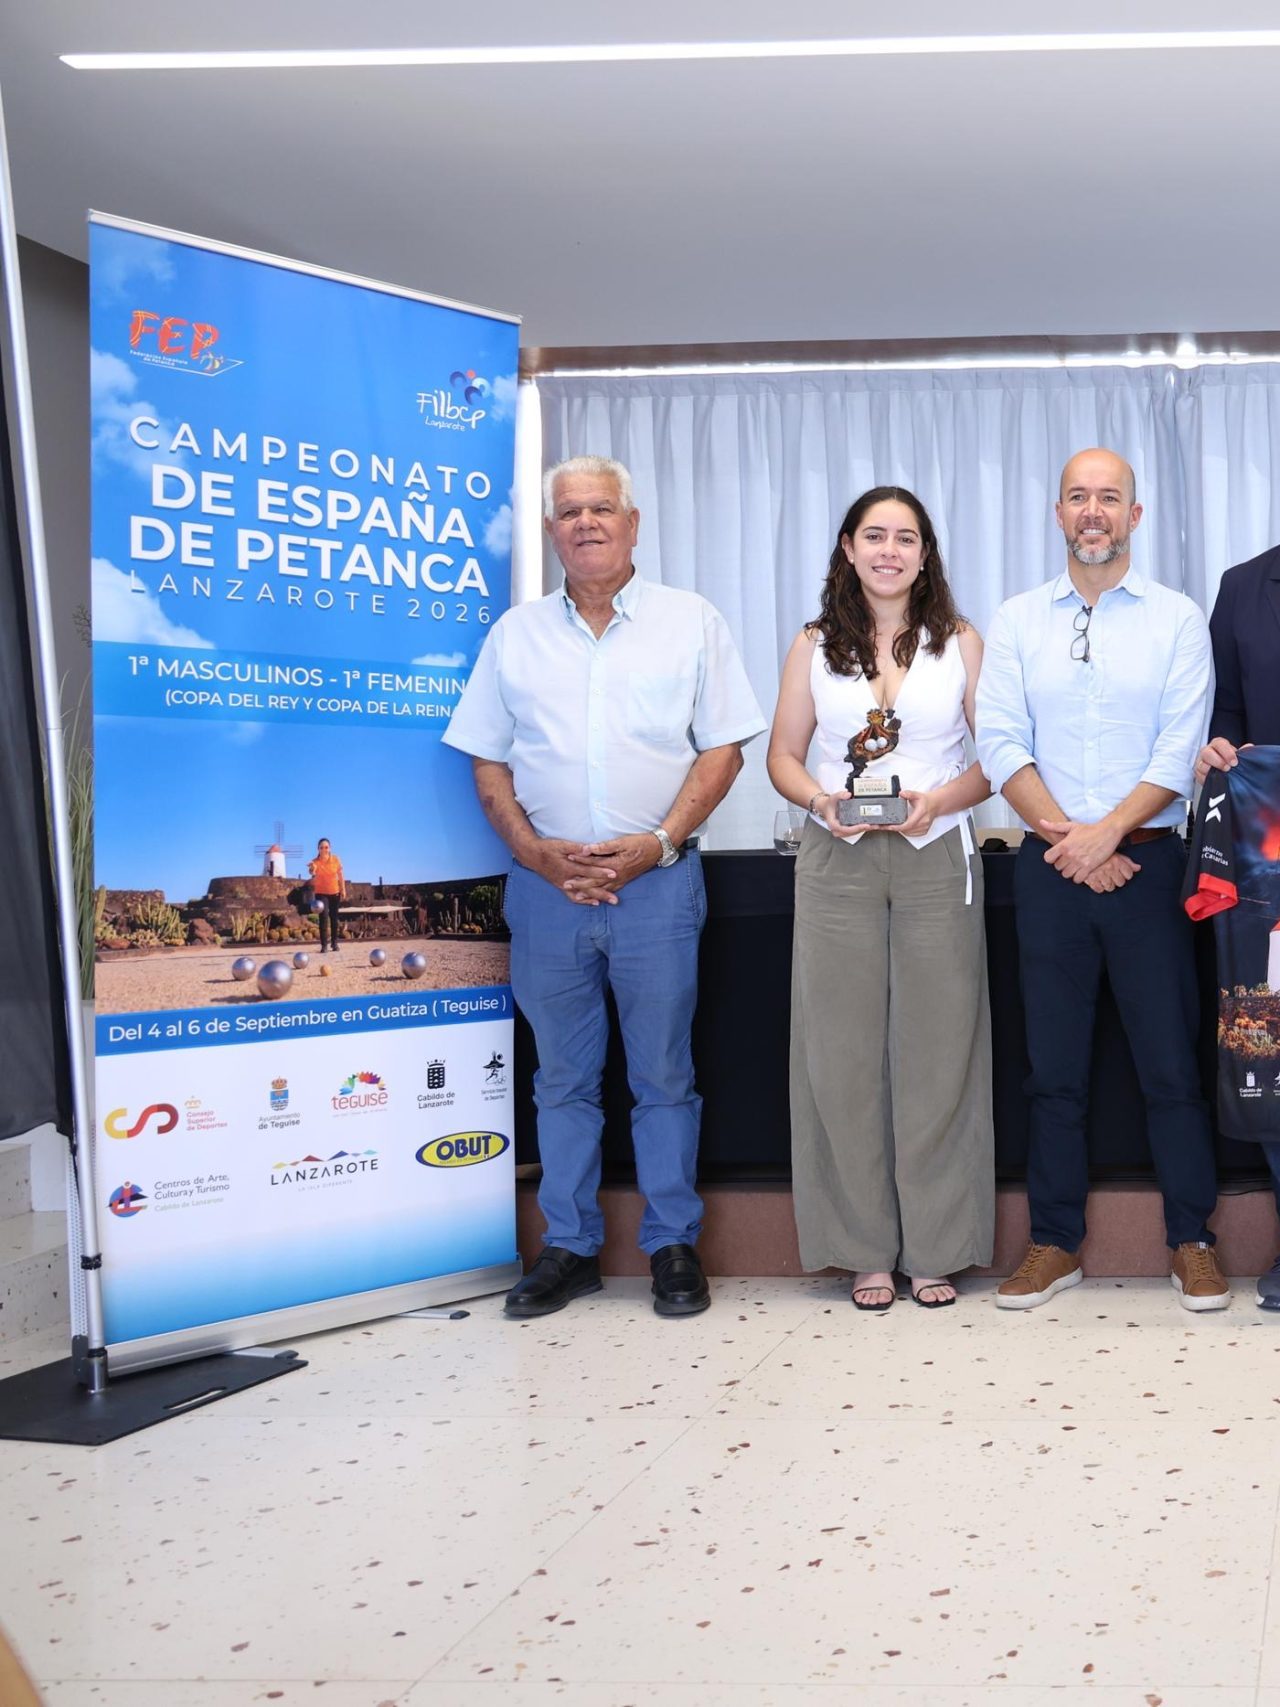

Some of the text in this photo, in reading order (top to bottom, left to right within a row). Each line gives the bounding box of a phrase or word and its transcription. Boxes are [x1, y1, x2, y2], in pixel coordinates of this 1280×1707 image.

[129, 310, 220, 360] FEP
[130, 415, 491, 499] CAMPEONATO
[152, 463, 475, 548] DE ESPAÑA
[130, 515, 490, 597] DE PETANCA
[130, 570, 491, 624] LANZAROTE 2026
[128, 655, 149, 676] 1ª
[157, 658, 323, 687] MASCULINOS
[343, 670, 361, 689] 1ª
[368, 672, 466, 696] FEMENIN
[165, 688, 457, 718] (COPA DEL REY Y COPA DE LA REIN
[109, 1025, 142, 1042] Del
[147, 1023, 162, 1039] 4
[166, 1021, 182, 1037] al
[188, 1020, 200, 1035] 6
[205, 1018, 230, 1034] de
[235, 1010, 337, 1035] Septiembre
[342, 1009, 363, 1022] en
[367, 1002, 428, 1020] Guatiza
[441, 997, 499, 1017] Teguise
[417, 1092, 445, 1102] Cabildo
[418, 1100, 454, 1109] Lanzarote
[258, 1119, 300, 1130] de Teguise
[436, 1135, 491, 1161] OBUT
[154, 1174, 230, 1191] Centros de Arte,
[271, 1159, 379, 1185] LANZAROTE
[196, 1183, 230, 1194] Turismo
[154, 1203, 181, 1212] Cabildo
[192, 1197, 224, 1207] Lanzarote
